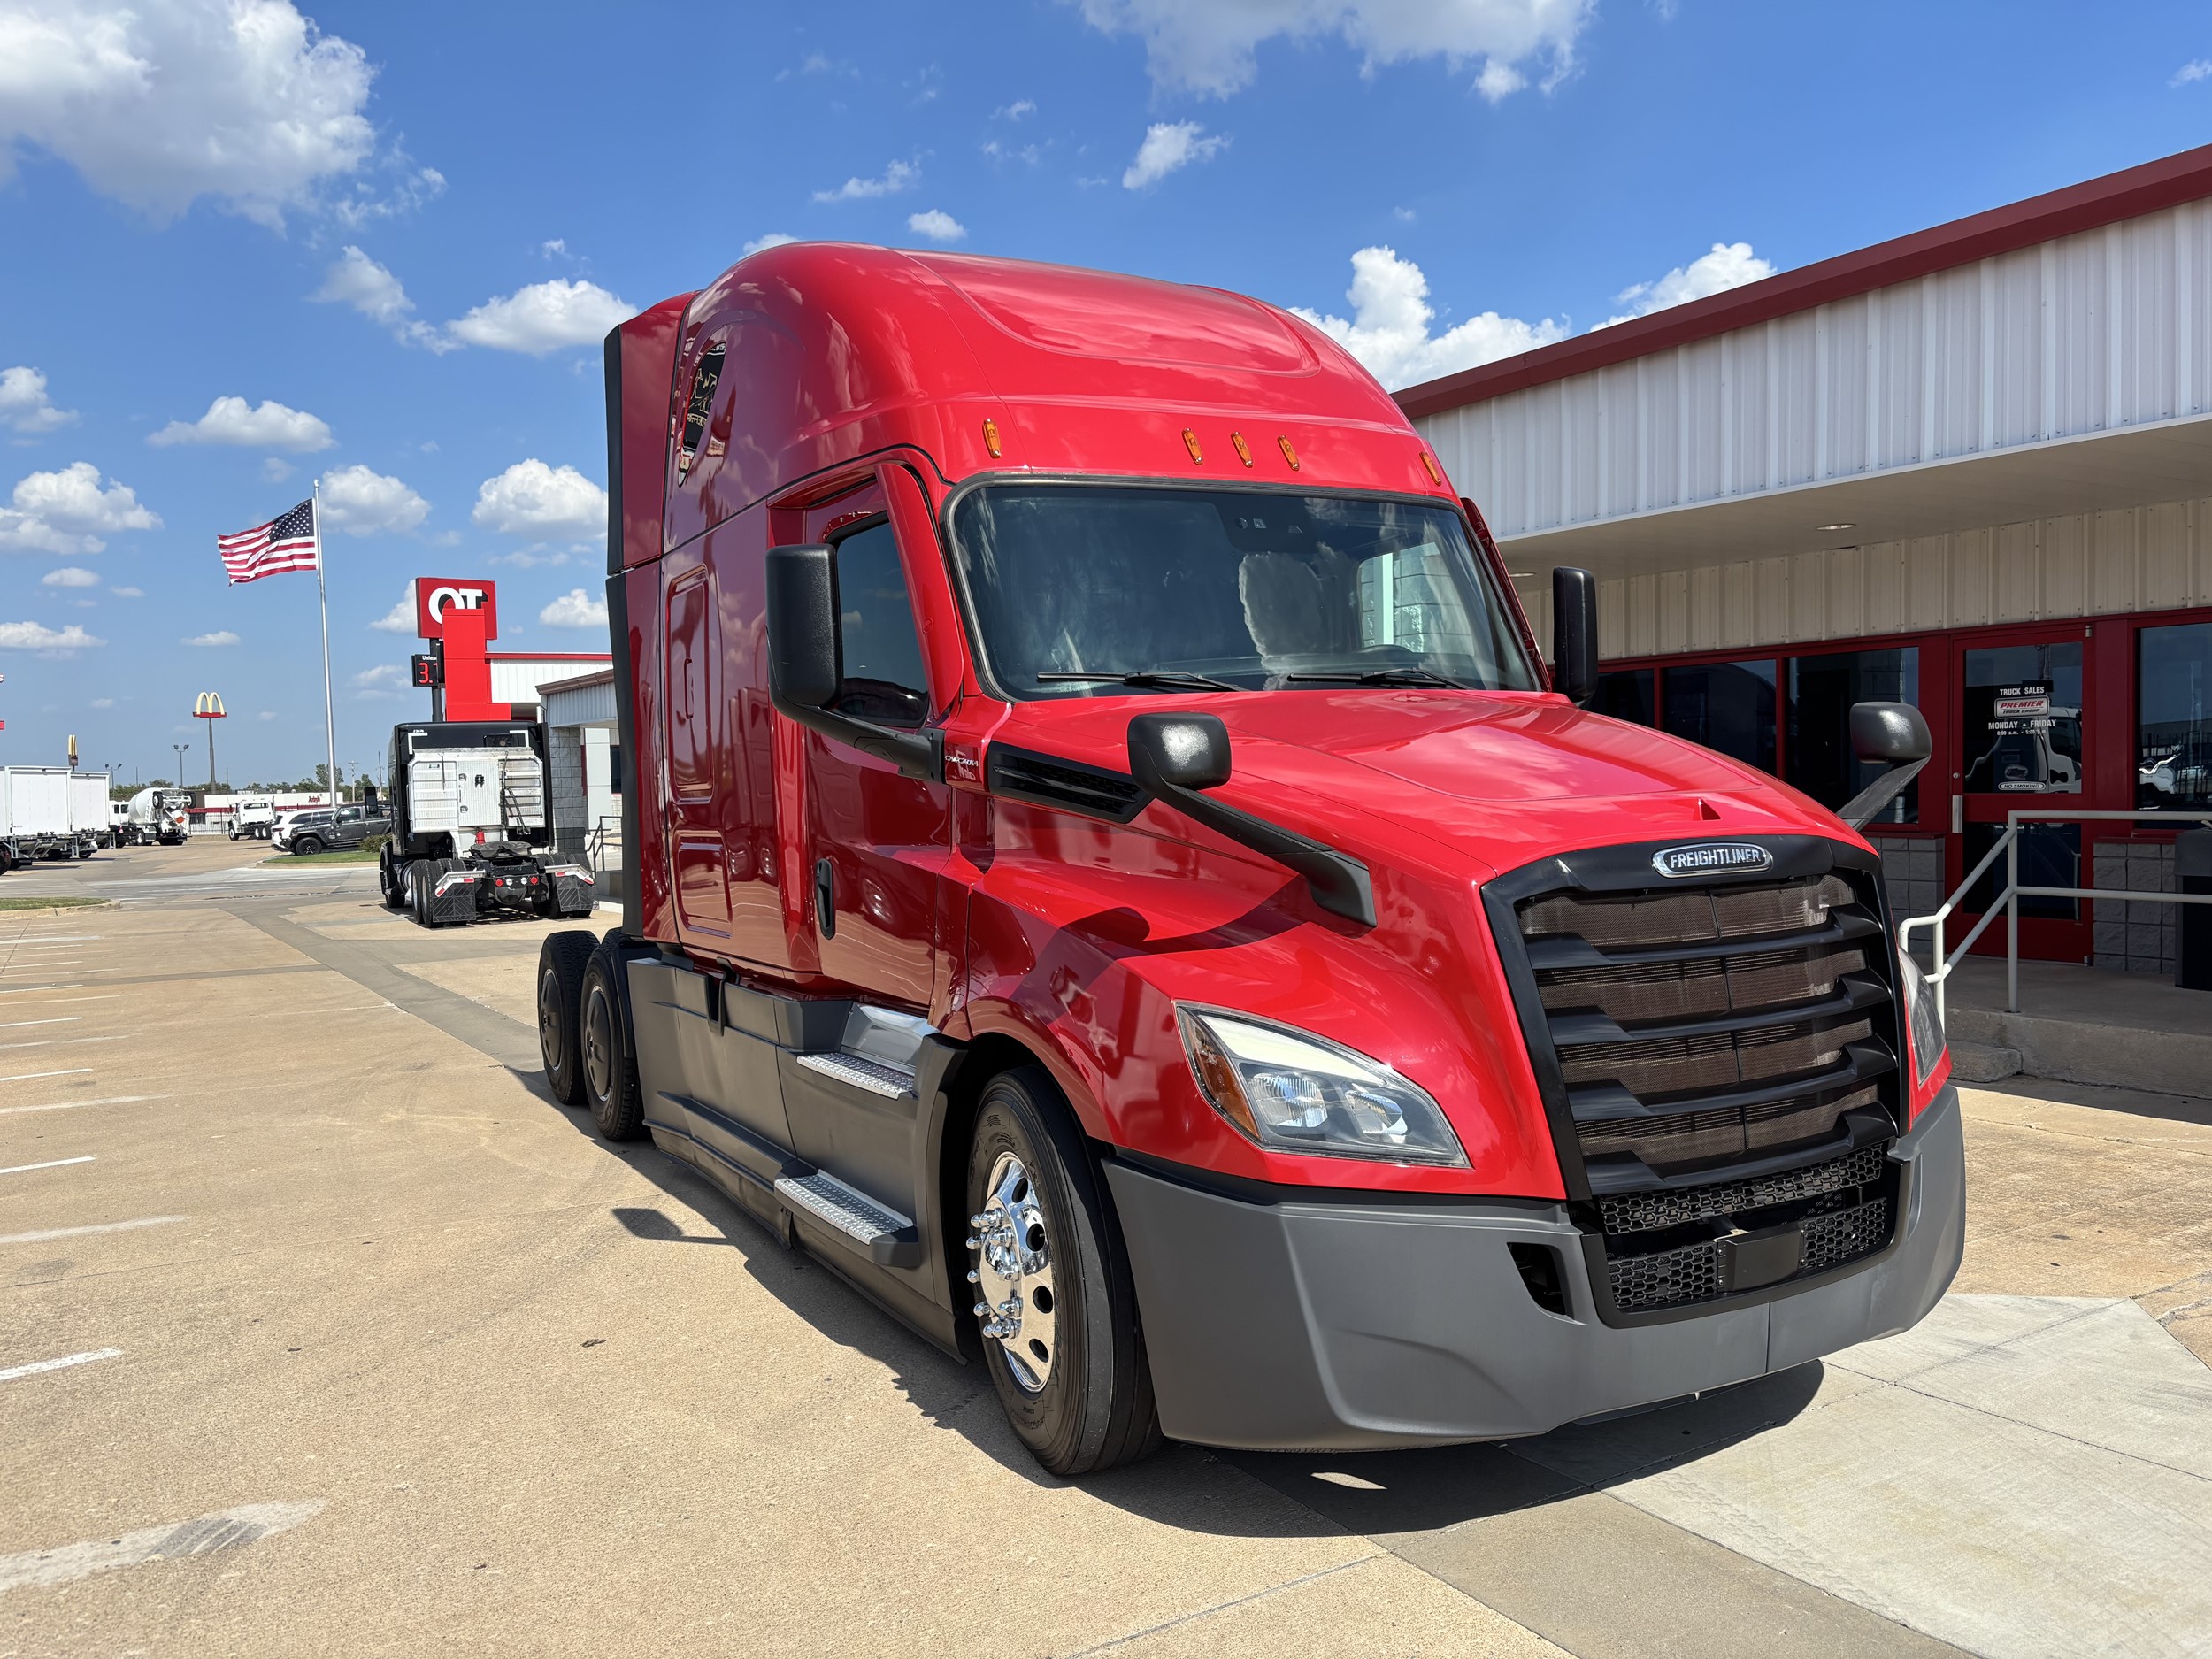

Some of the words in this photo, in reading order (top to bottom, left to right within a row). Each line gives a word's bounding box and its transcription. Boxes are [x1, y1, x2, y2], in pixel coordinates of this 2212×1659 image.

[418, 662, 438, 684] 3.
[1988, 721, 2018, 730] MONDAY
[1671, 849, 1761, 868] FREIGHTLINER
